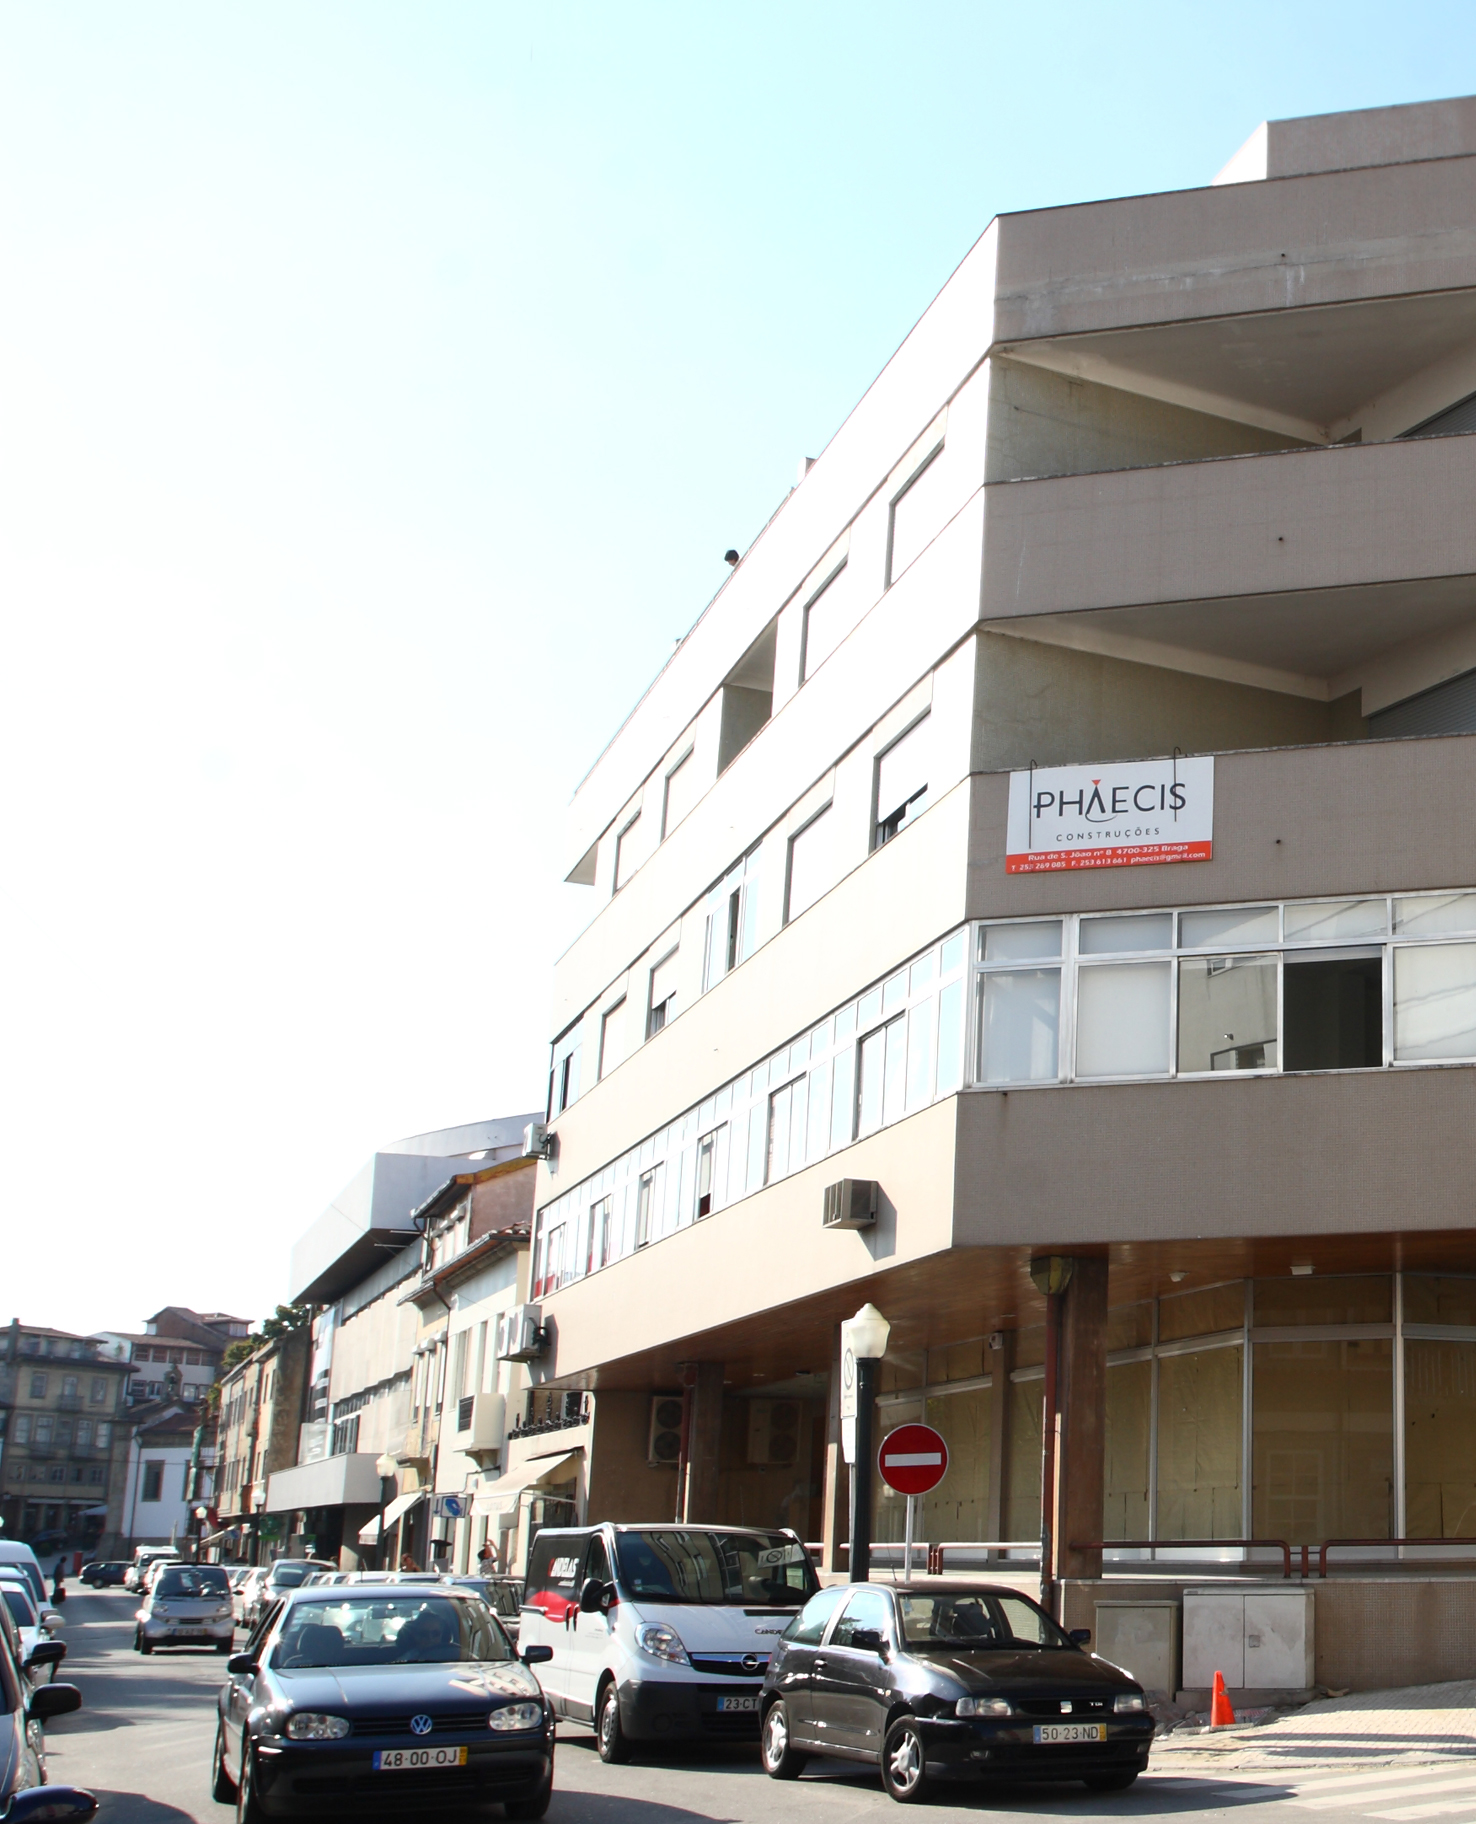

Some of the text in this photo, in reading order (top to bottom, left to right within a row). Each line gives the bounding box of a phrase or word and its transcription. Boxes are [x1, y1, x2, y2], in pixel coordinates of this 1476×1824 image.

[1033, 780, 1187, 821] PHAECIS
[1056, 827, 1160, 842] CONSTRUÇÕES
[1060, 851, 1068, 859] S.
[1105, 848, 1112, 856] 8
[1116, 845, 1159, 855] 4700-325
[1161, 844, 1189, 853] Braga
[1035, 862, 1050, 870] 269
[1080, 859, 1095, 867] 253
[1112, 856, 1127, 864] 661
[1130, 852, 1206, 864] phaecis@gmail.com
